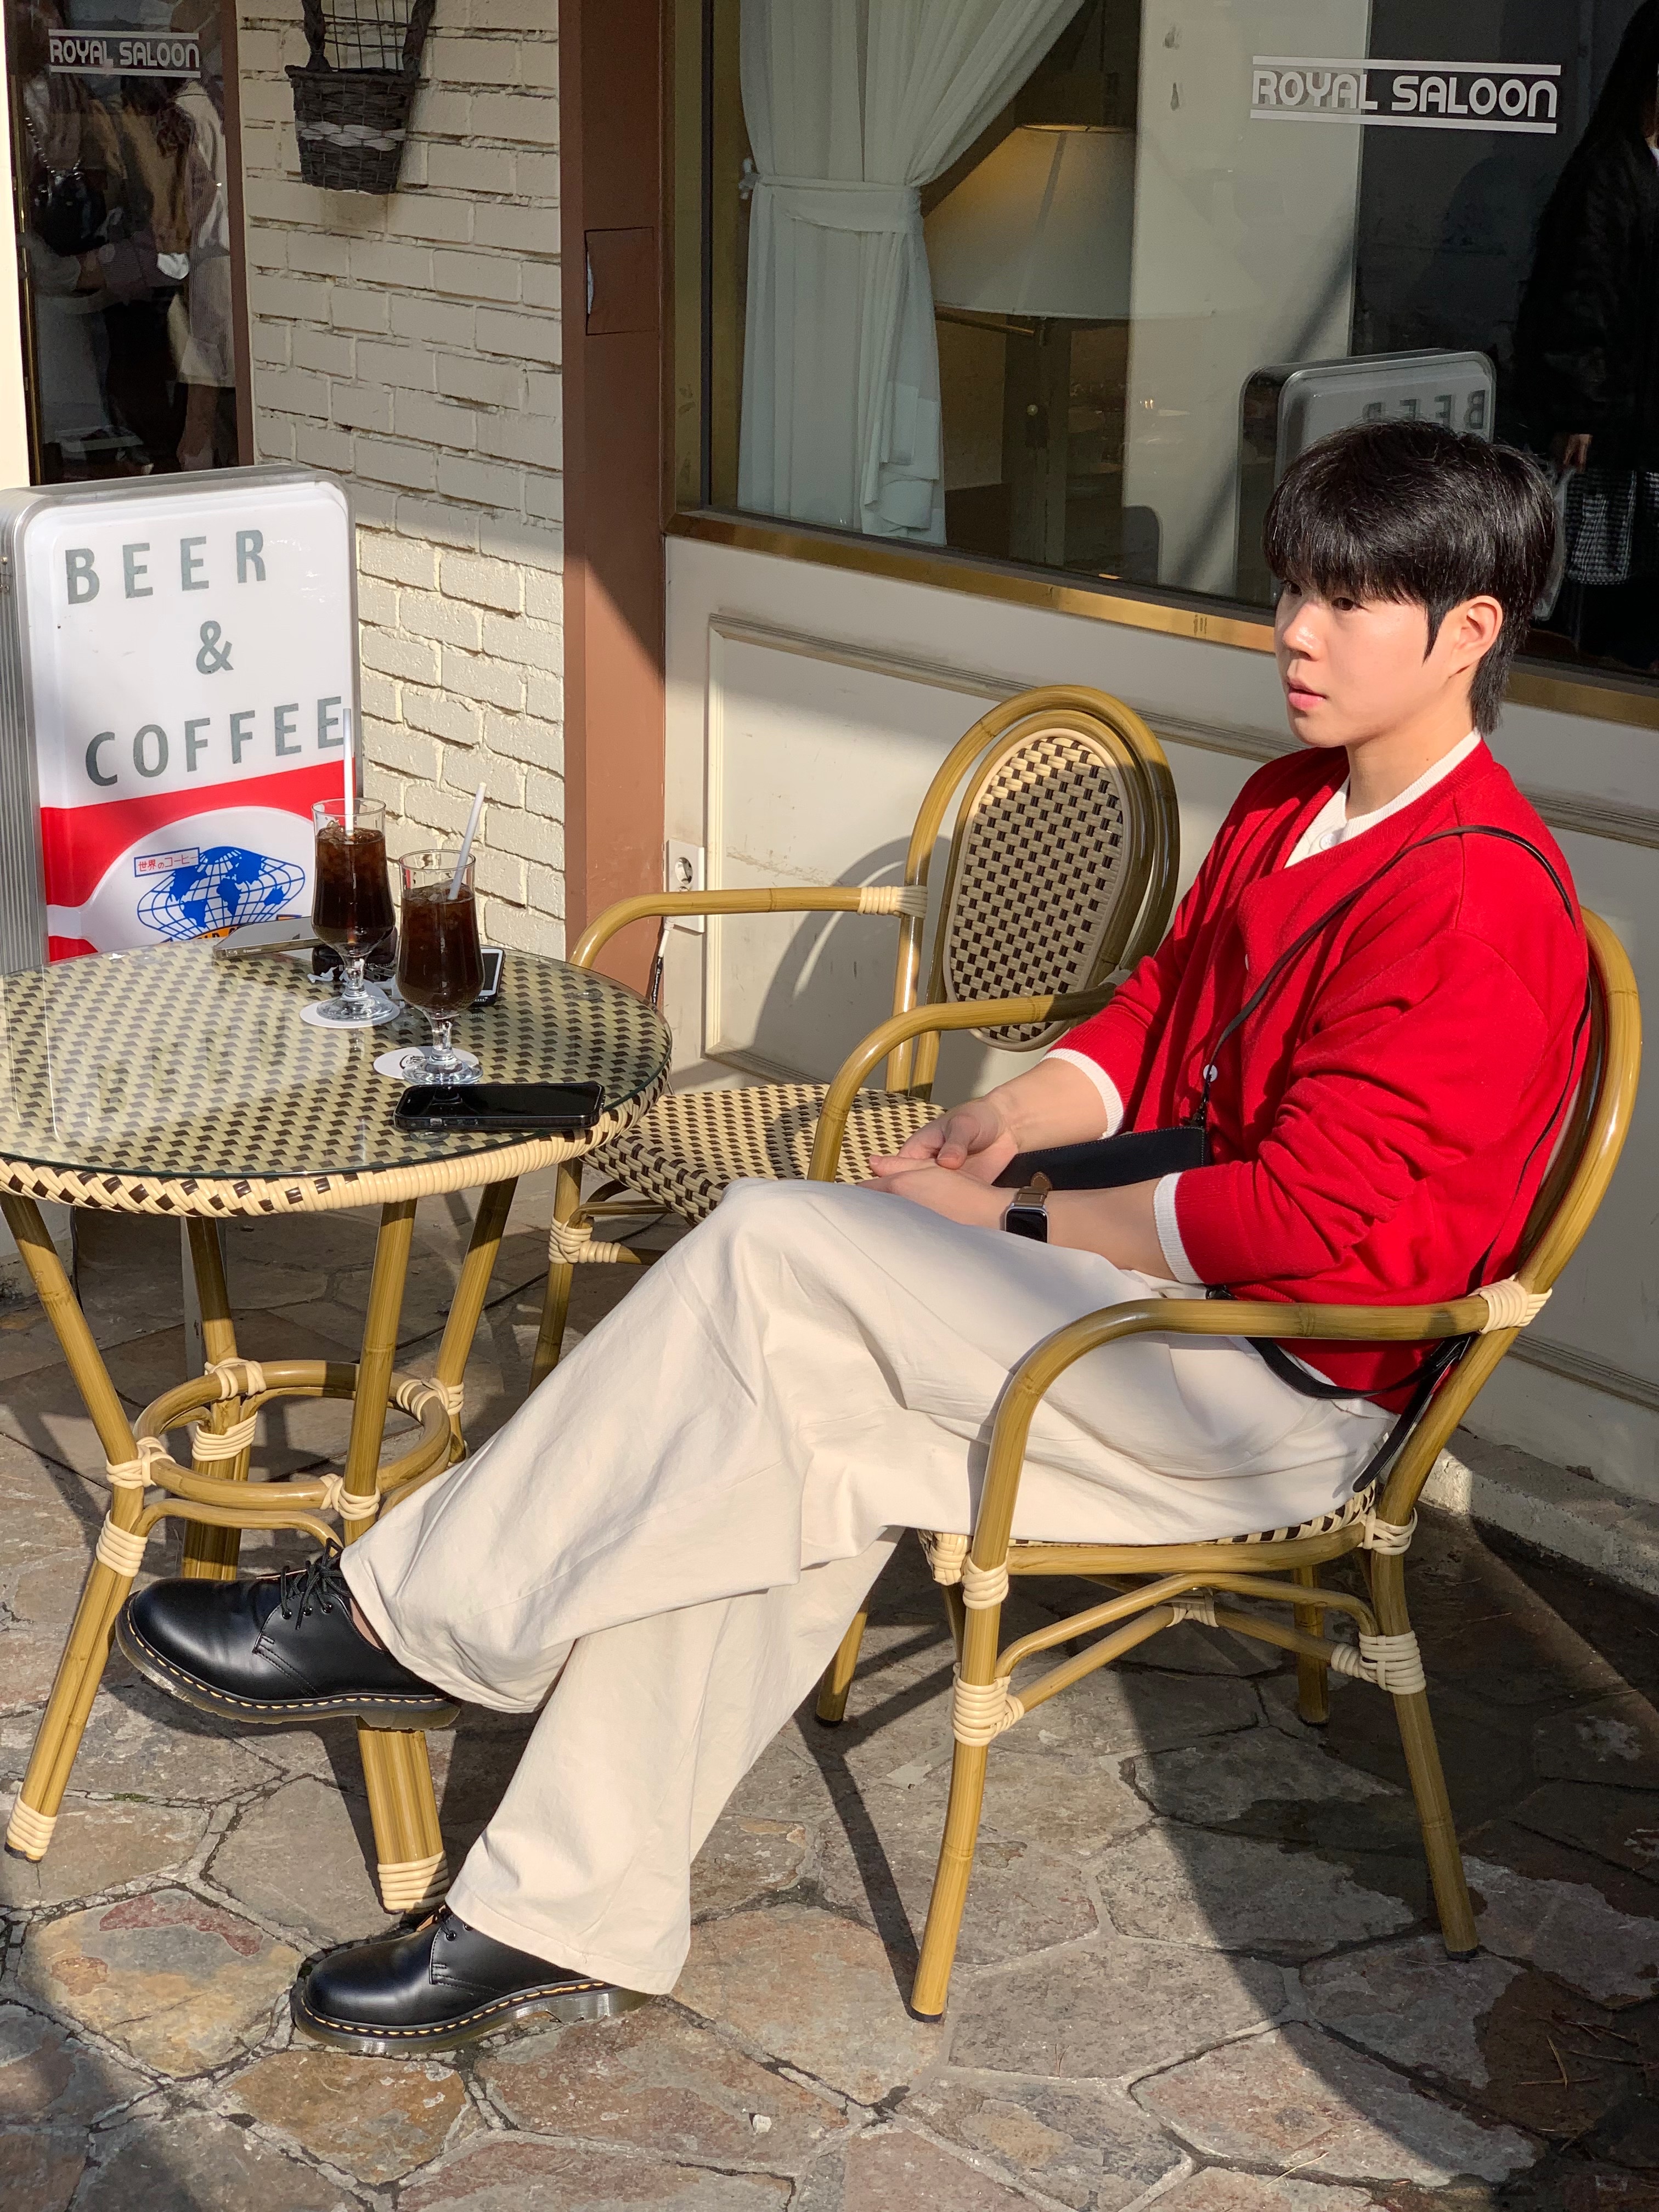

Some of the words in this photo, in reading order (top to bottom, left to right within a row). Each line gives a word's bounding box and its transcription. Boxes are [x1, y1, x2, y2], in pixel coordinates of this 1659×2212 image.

[49, 39, 114, 66] ROYAL
[119, 41, 200, 68] SALOON
[1252, 70, 1378, 110] ROYAL
[1391, 75, 1558, 119] SALOON
[65, 529, 266, 605] BEER
[196, 620, 234, 675] &
[85, 696, 344, 786] COFFEE
[138, 854, 199, 872] 世界のコーヒー
